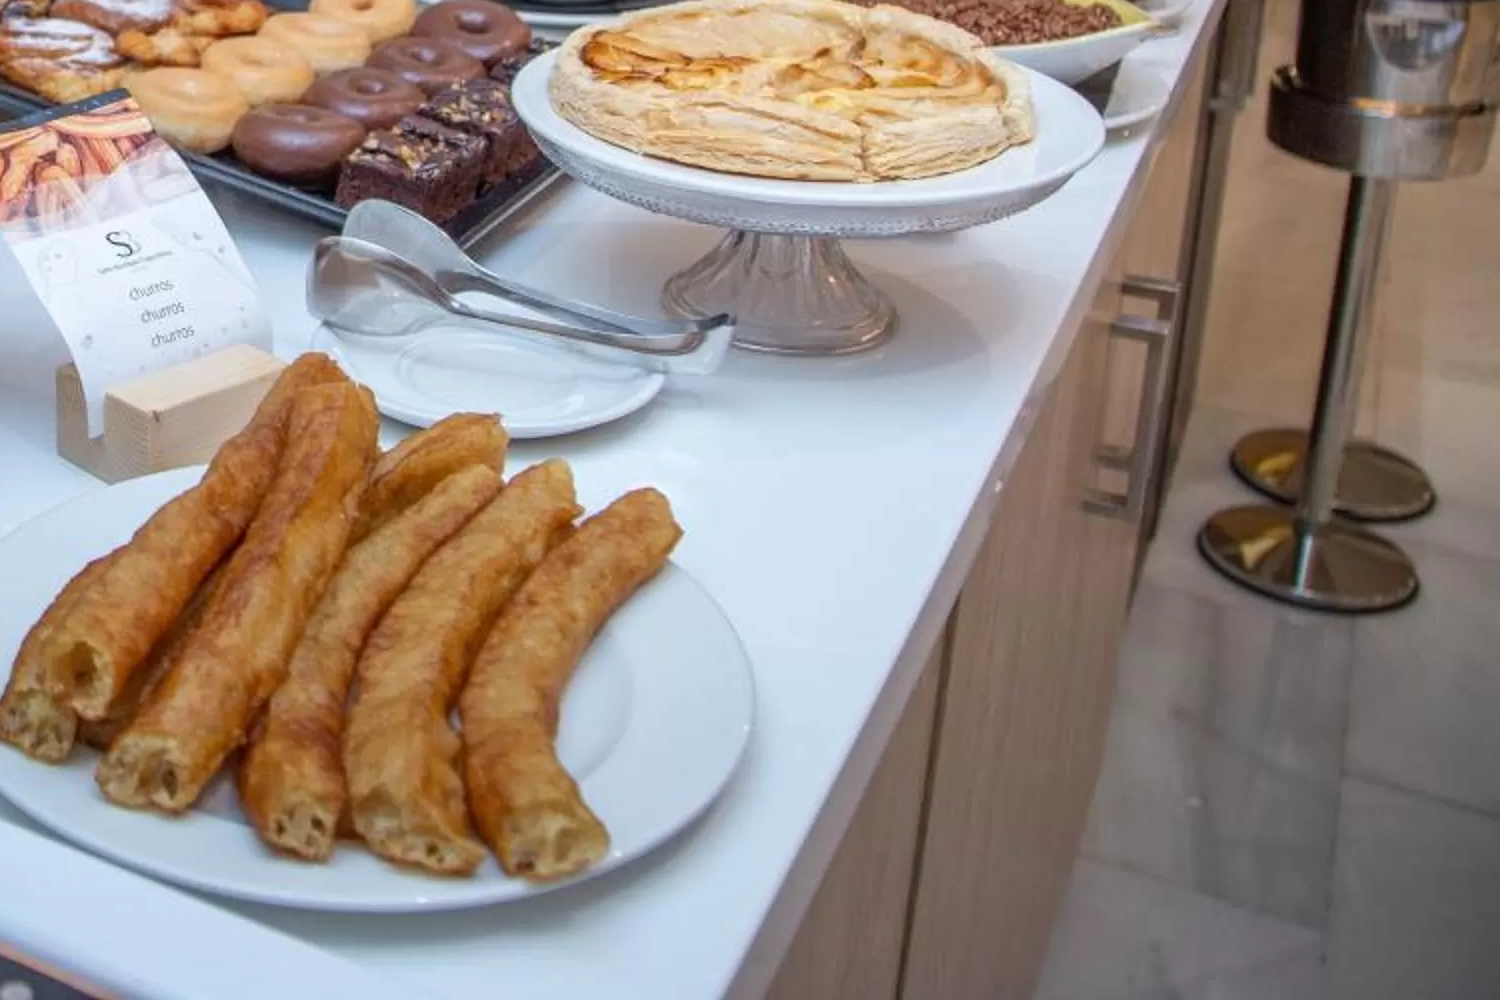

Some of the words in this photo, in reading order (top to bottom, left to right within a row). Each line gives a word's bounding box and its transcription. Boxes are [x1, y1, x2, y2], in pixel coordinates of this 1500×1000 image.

[129, 279, 174, 301] churros
[141, 301, 185, 324] churros
[151, 325, 195, 348] churros
